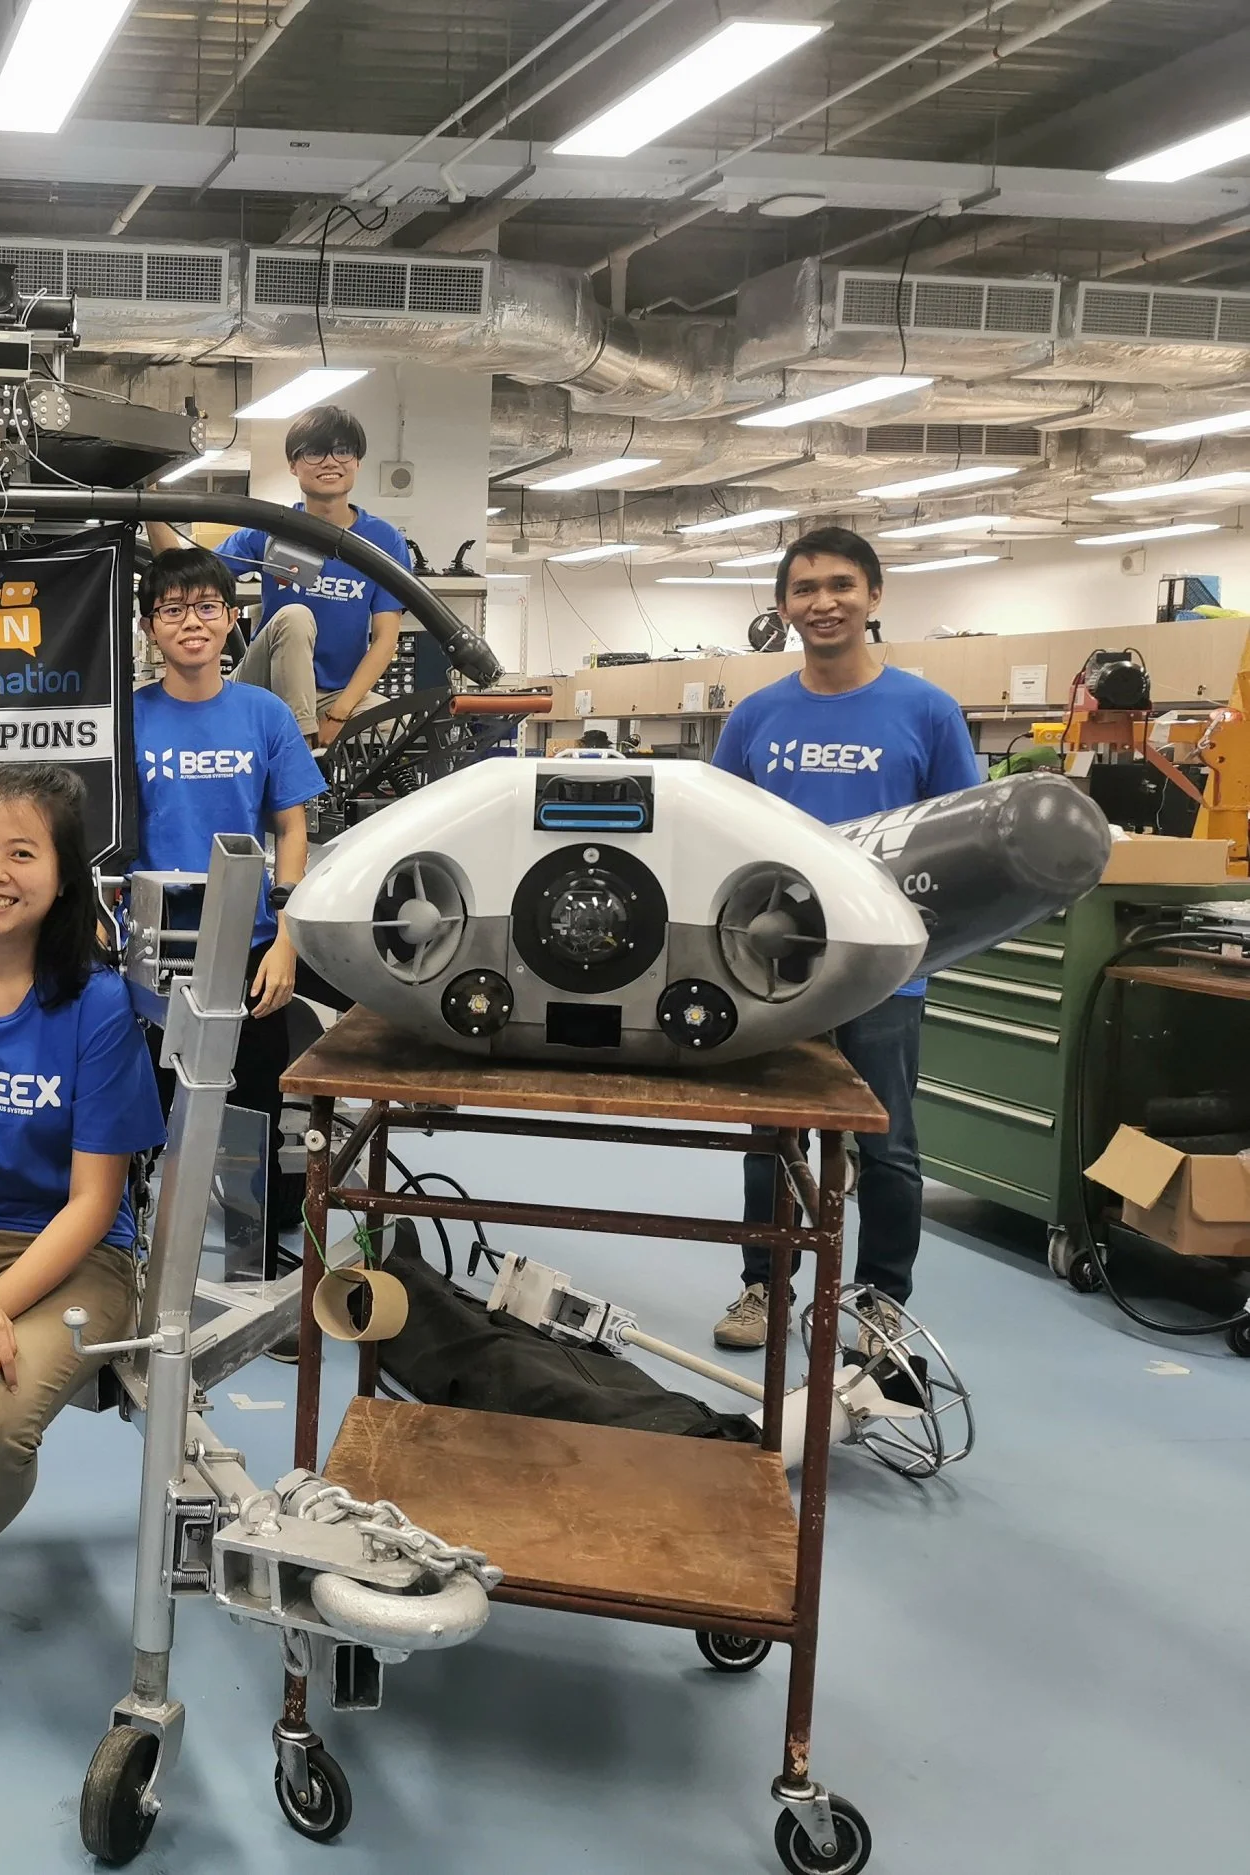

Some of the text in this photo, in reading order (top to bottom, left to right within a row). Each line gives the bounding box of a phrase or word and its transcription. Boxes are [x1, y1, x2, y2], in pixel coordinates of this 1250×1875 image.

[3, 615, 30, 642] N
[179, 750, 254, 775] BEEX
[800, 743, 883, 772] BEEX
[903, 871, 939, 896] CO.
[7, 1107, 34, 1116] SYSTEMS
